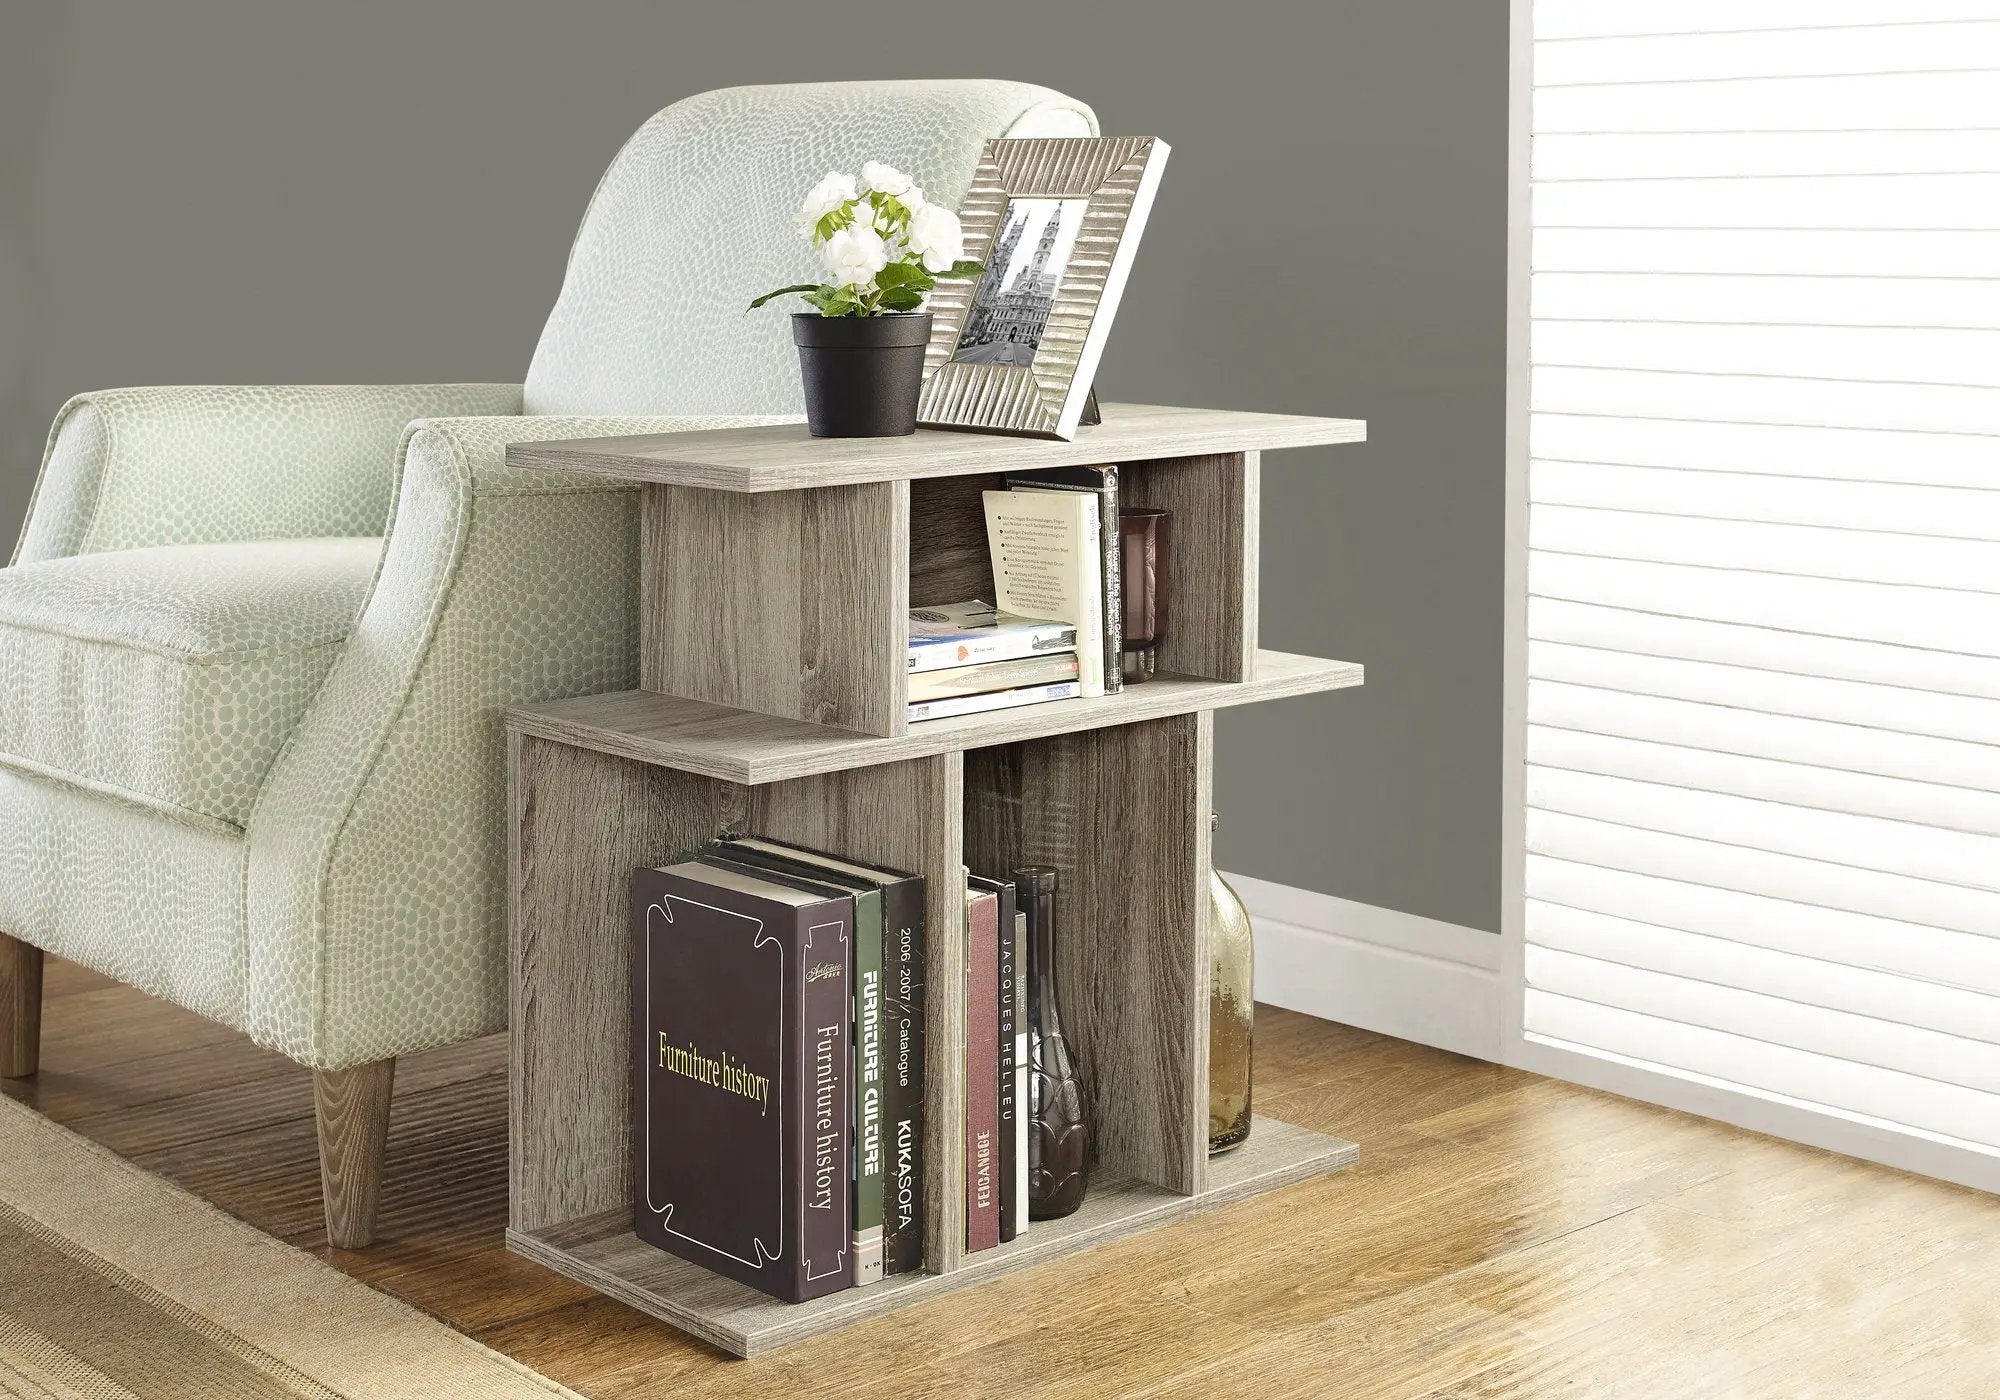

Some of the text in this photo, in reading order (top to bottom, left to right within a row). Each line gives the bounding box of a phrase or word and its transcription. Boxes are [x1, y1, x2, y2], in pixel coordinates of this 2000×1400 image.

[1112, 547, 1121, 573] House
[1113, 598, 1121, 622] Seven
[1113, 623, 1122, 653] Gables
[897, 1018, 911, 1087] Catalogue
[1002, 939, 1012, 1120] JACQUES HELLEU
[659, 1031, 769, 1117] Furniture history
[809, 1023, 839, 1210] Furniture history
[864, 1088, 879, 1177] CULTURE
[897, 1120, 912, 1230] KUKASOFA
